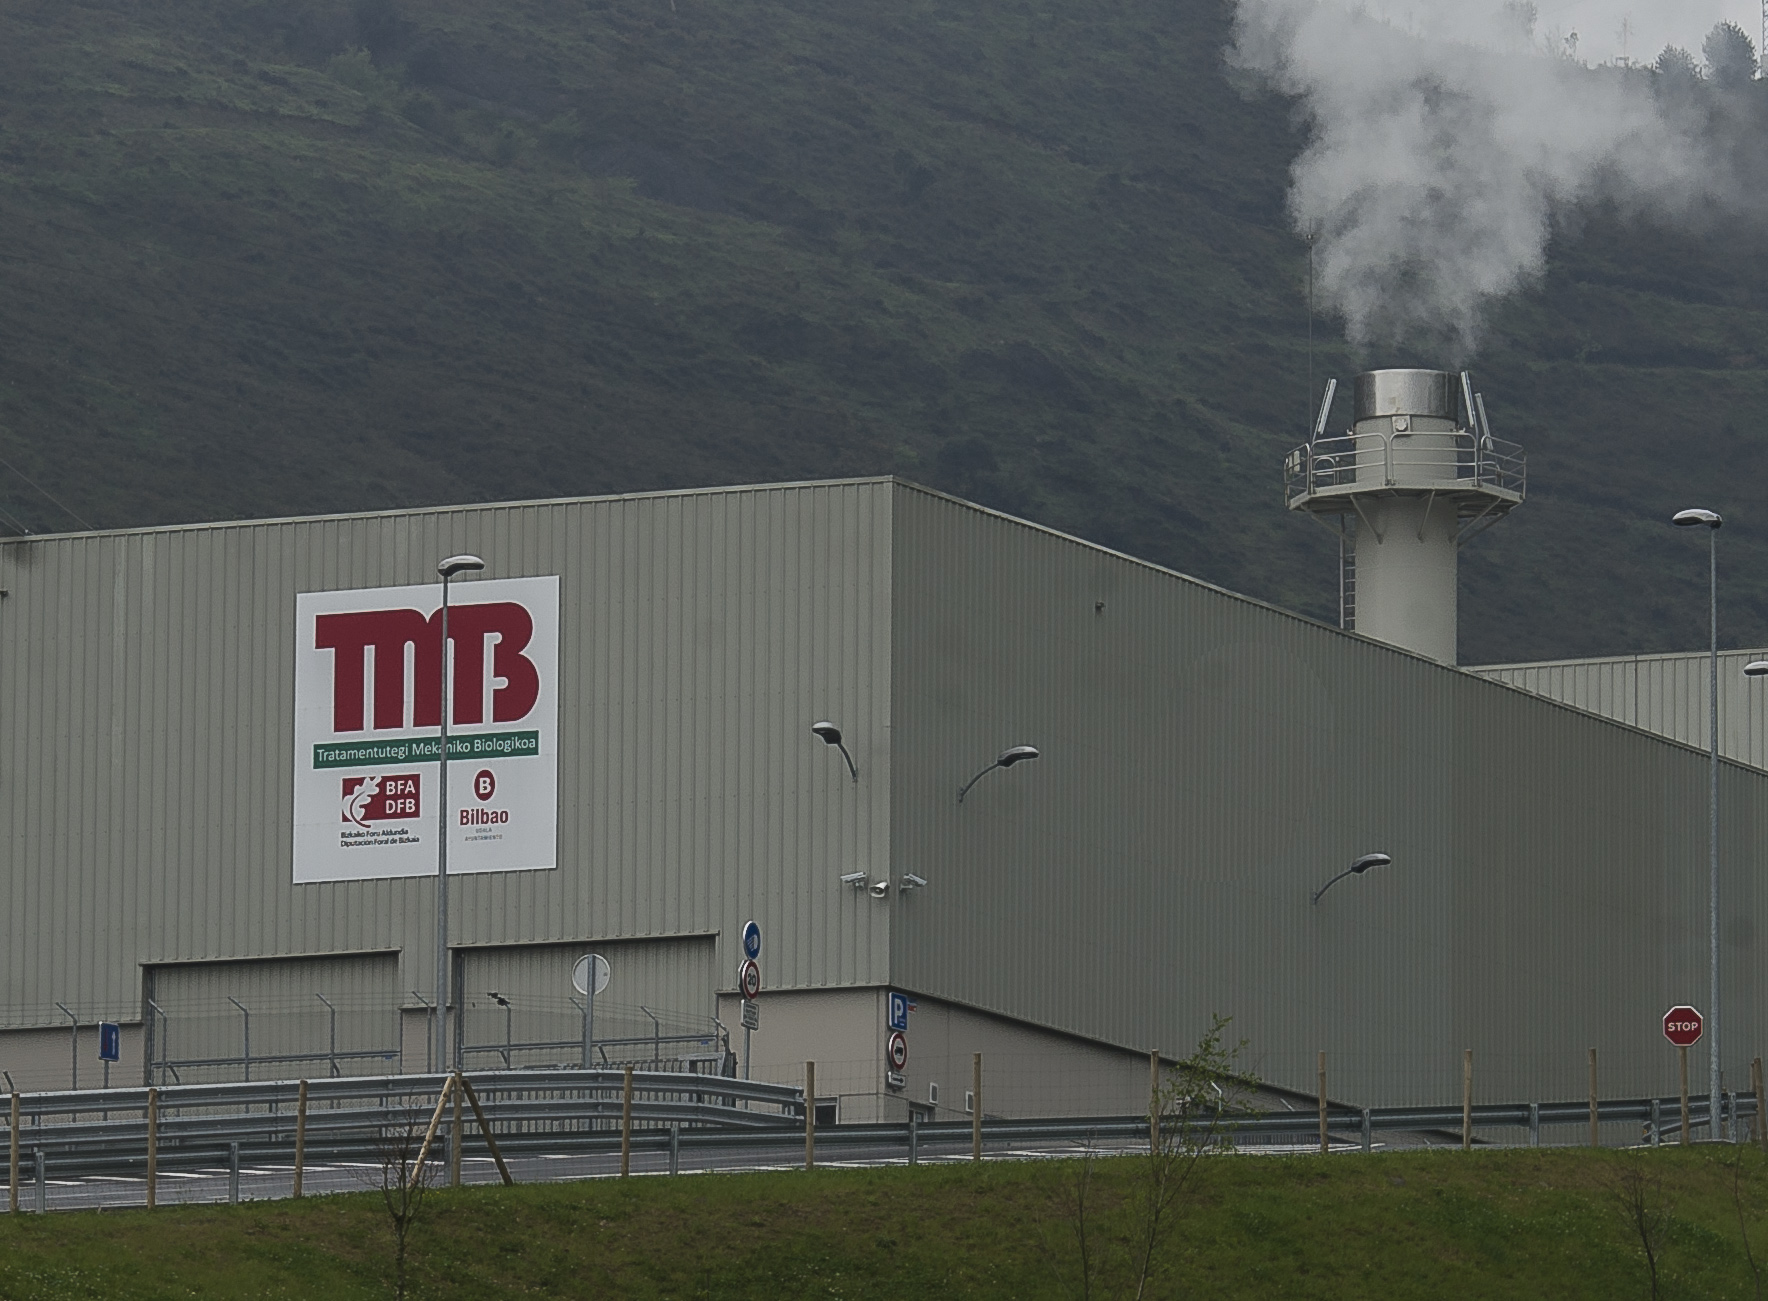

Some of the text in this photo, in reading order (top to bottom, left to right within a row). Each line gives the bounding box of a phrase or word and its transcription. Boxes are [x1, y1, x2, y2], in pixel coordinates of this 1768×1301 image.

[315, 602, 539, 732] TMB
[317, 743, 409, 761] Tratamentutegi
[474, 736, 536, 753] Biologikoa
[386, 780, 416, 795] BFA
[479, 777, 492, 794] B
[386, 799, 416, 814] DFB
[460, 808, 509, 826] Bilbao
[747, 972, 757, 987] 20
[1667, 1021, 1699, 1032] STOP
